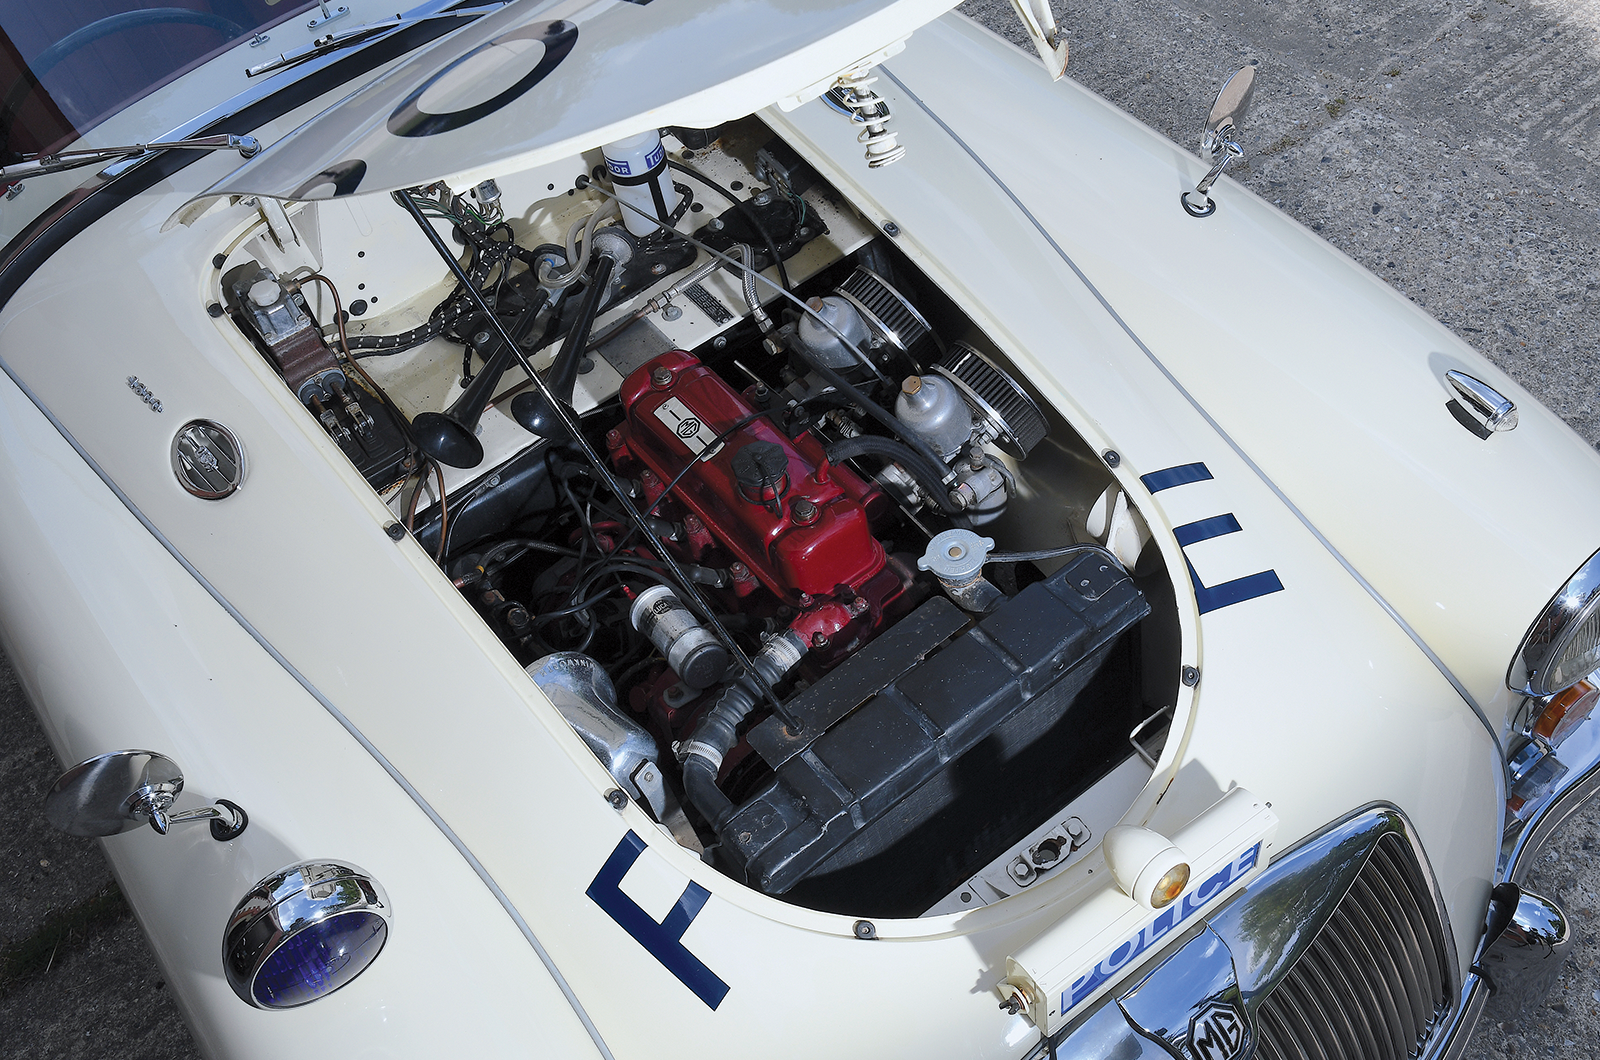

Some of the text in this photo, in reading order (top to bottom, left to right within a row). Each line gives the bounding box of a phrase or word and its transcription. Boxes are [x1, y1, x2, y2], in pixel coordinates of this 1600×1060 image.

[679, 419, 699, 437] MG
[1062, 844, 1260, 1013] POLICE
[1194, 1009, 1242, 1060] MG
